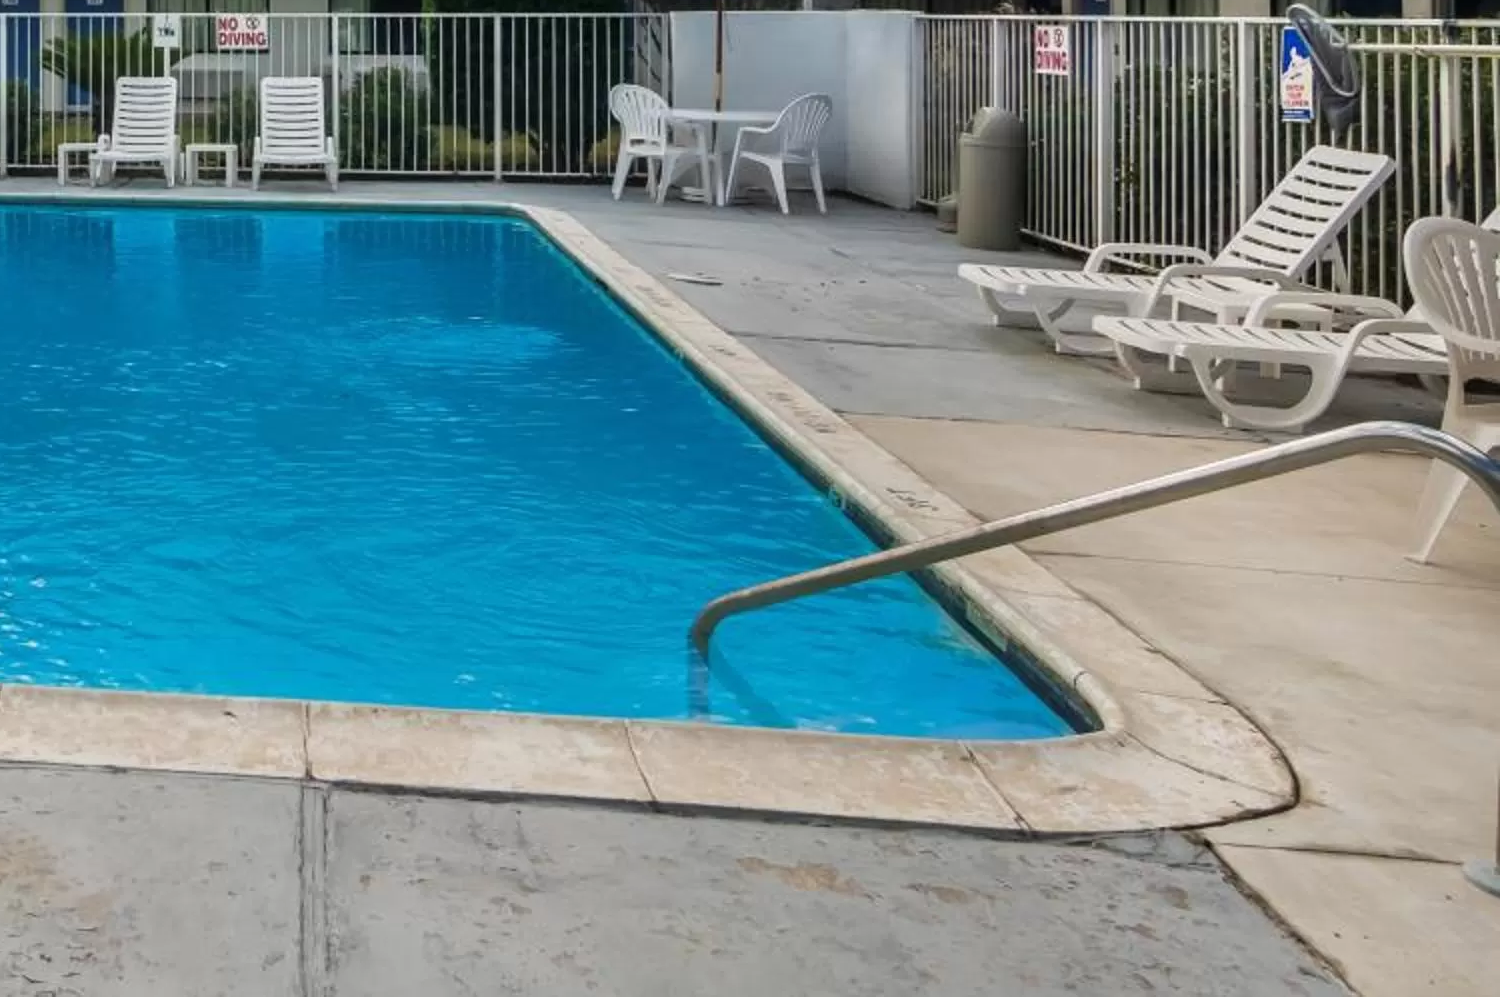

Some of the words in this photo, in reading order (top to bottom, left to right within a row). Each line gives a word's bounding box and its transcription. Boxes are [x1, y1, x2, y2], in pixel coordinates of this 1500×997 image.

[218, 17, 238, 31] NO
[218, 32, 266, 45] DIVING
[1036, 29, 1049, 48] NO
[1036, 50, 1067, 71] DIVING
